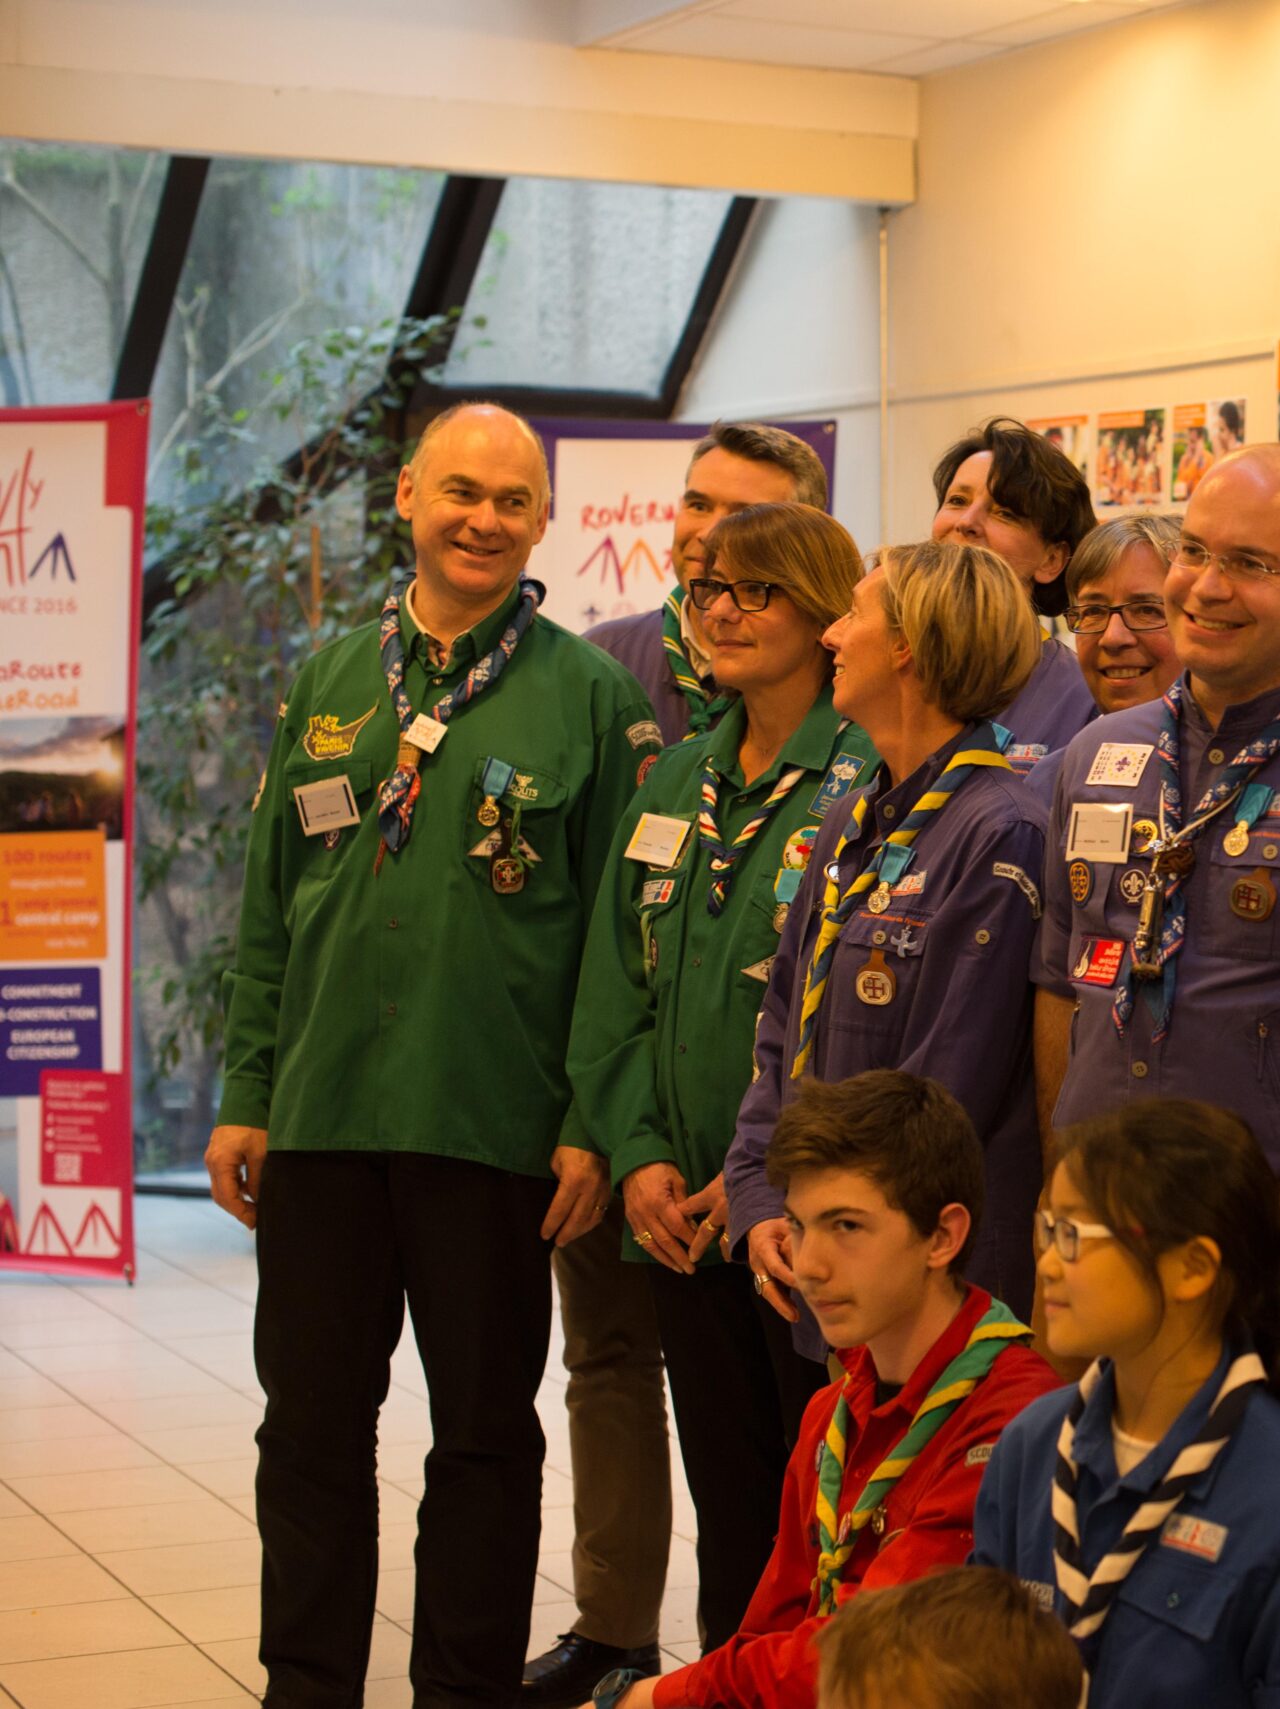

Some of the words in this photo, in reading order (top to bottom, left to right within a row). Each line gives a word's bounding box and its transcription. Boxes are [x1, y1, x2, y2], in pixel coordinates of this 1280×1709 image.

[1, 983, 82, 1000] COMMITMENT
[10, 1028, 75, 1044] EUROPEAN
[6, 1044, 80, 1060] CITIZENSHIP
